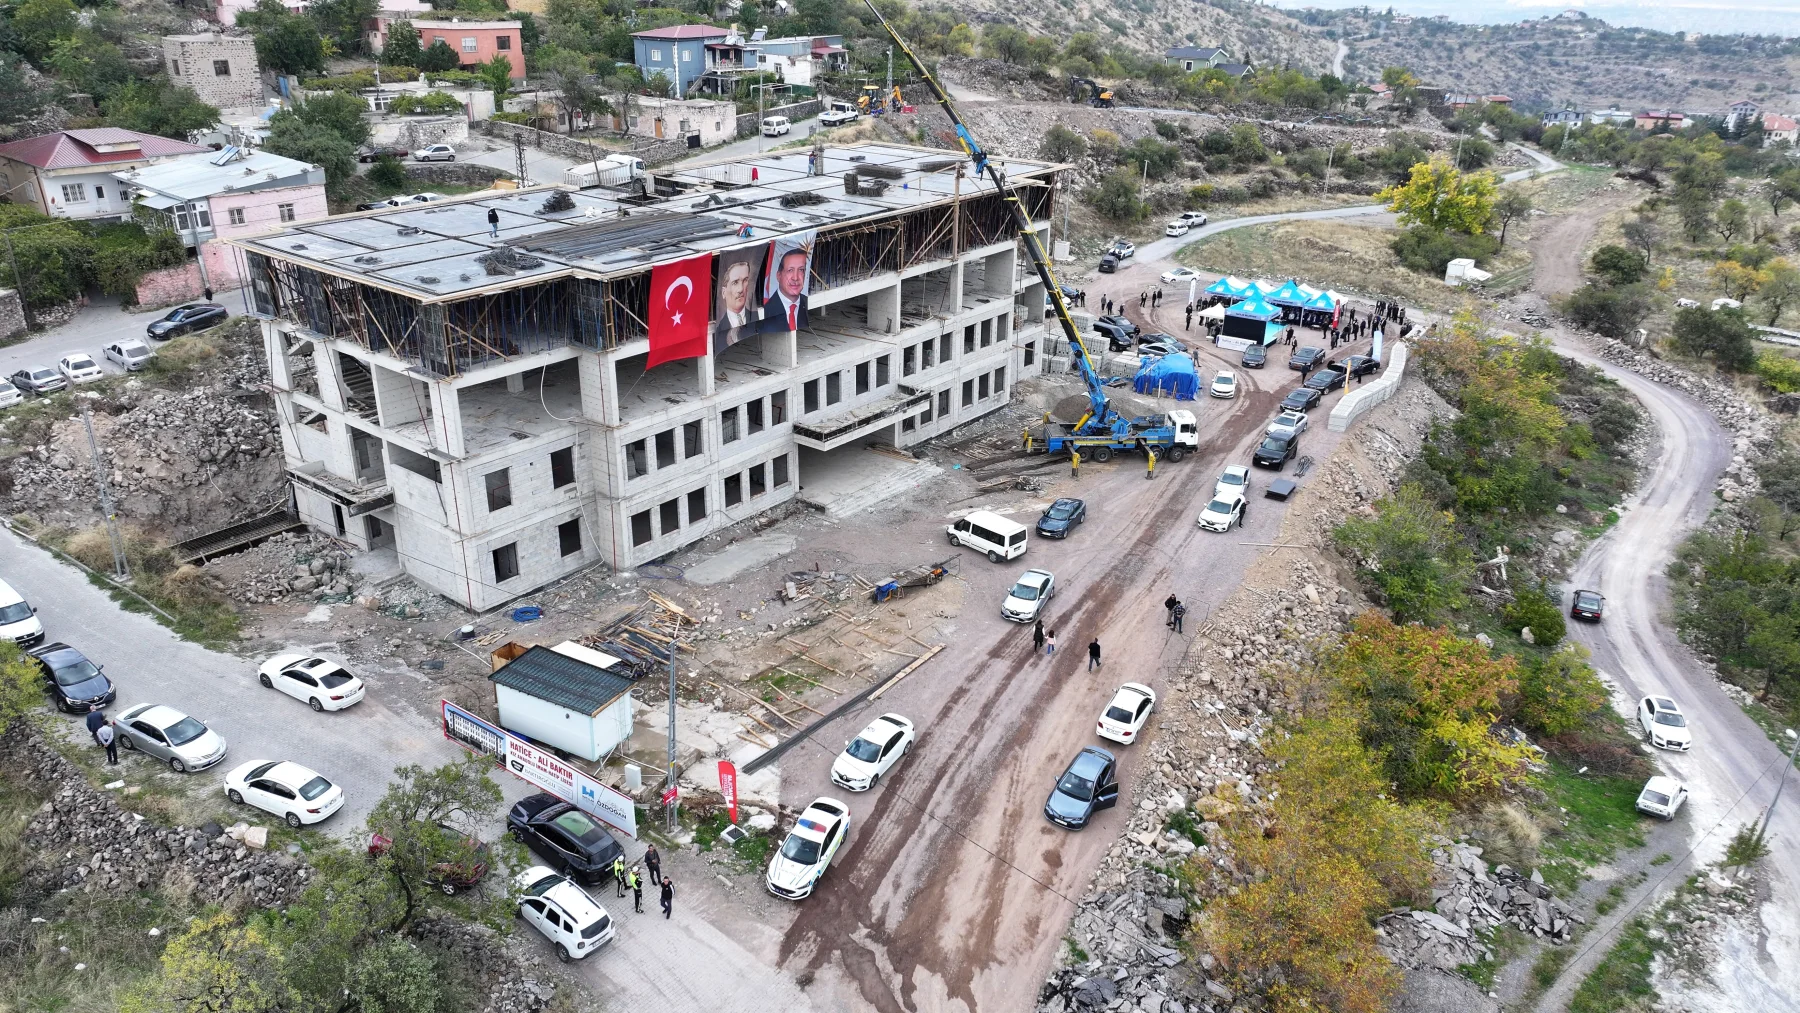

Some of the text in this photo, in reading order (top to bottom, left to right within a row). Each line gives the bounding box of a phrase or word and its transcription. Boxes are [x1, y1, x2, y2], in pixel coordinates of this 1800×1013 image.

[510, 741, 532, 758] HATİCE
[538, 756, 548, 766] ALİ
[550, 761, 573, 780] BAKTIR
